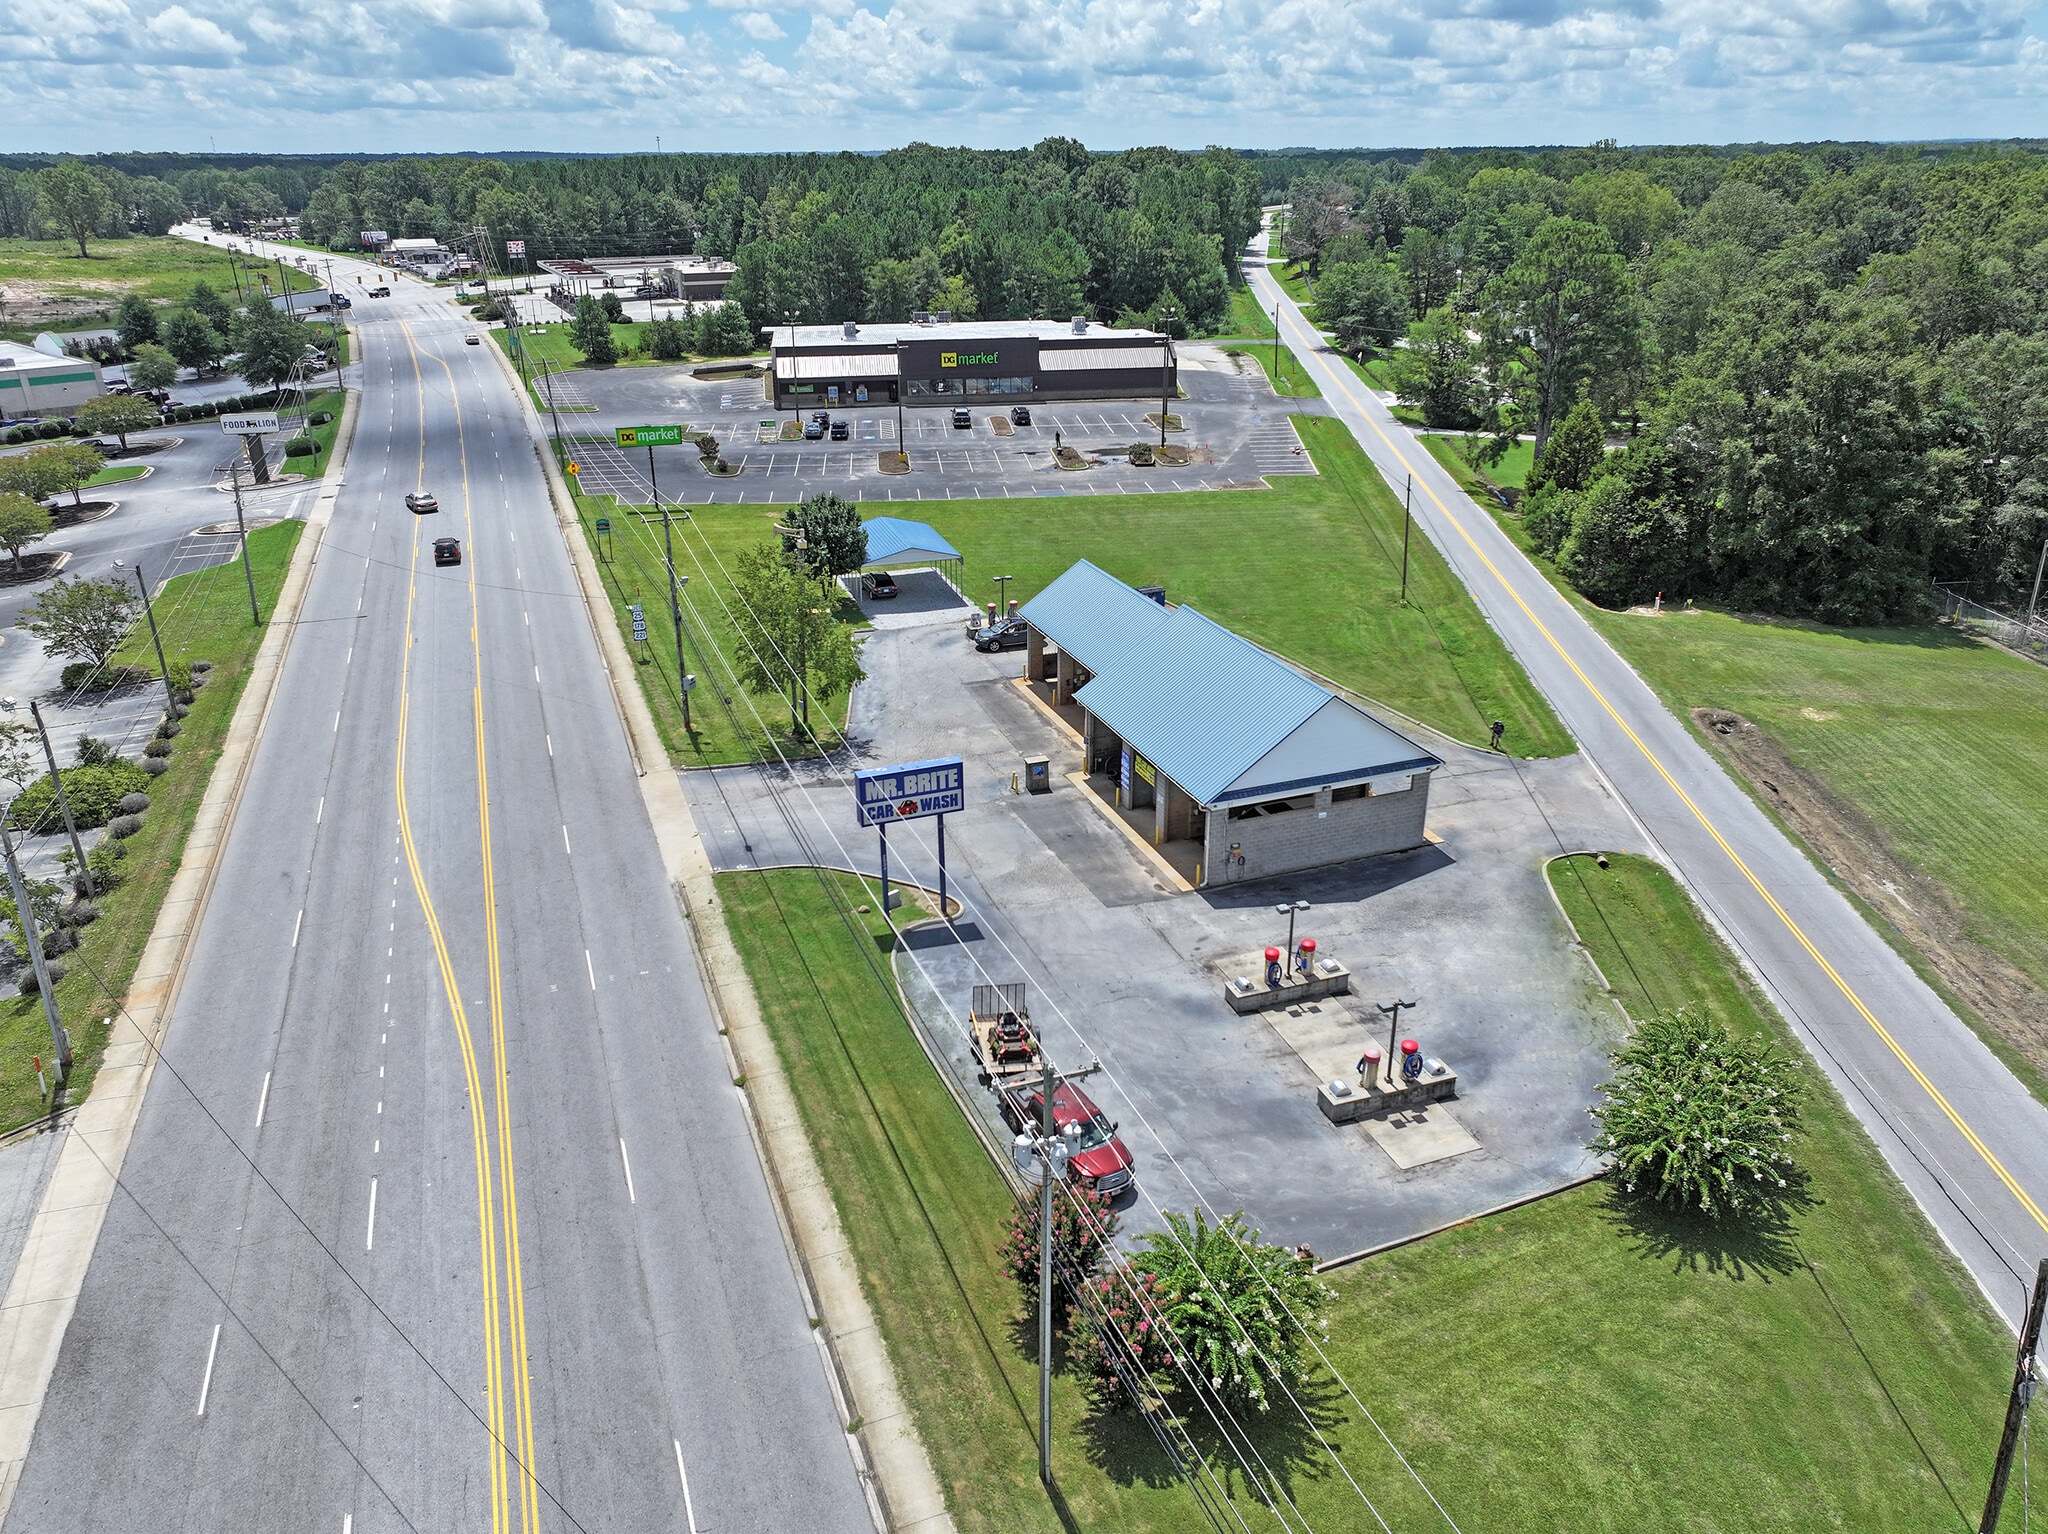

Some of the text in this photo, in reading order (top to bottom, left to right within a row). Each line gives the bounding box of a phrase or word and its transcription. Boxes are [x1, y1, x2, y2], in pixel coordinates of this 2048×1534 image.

[958, 352, 999, 366] market
[223, 419, 277, 429] FOOD LION
[621, 428, 680, 442] DG market
[866, 793, 959, 821] CAR WASH
